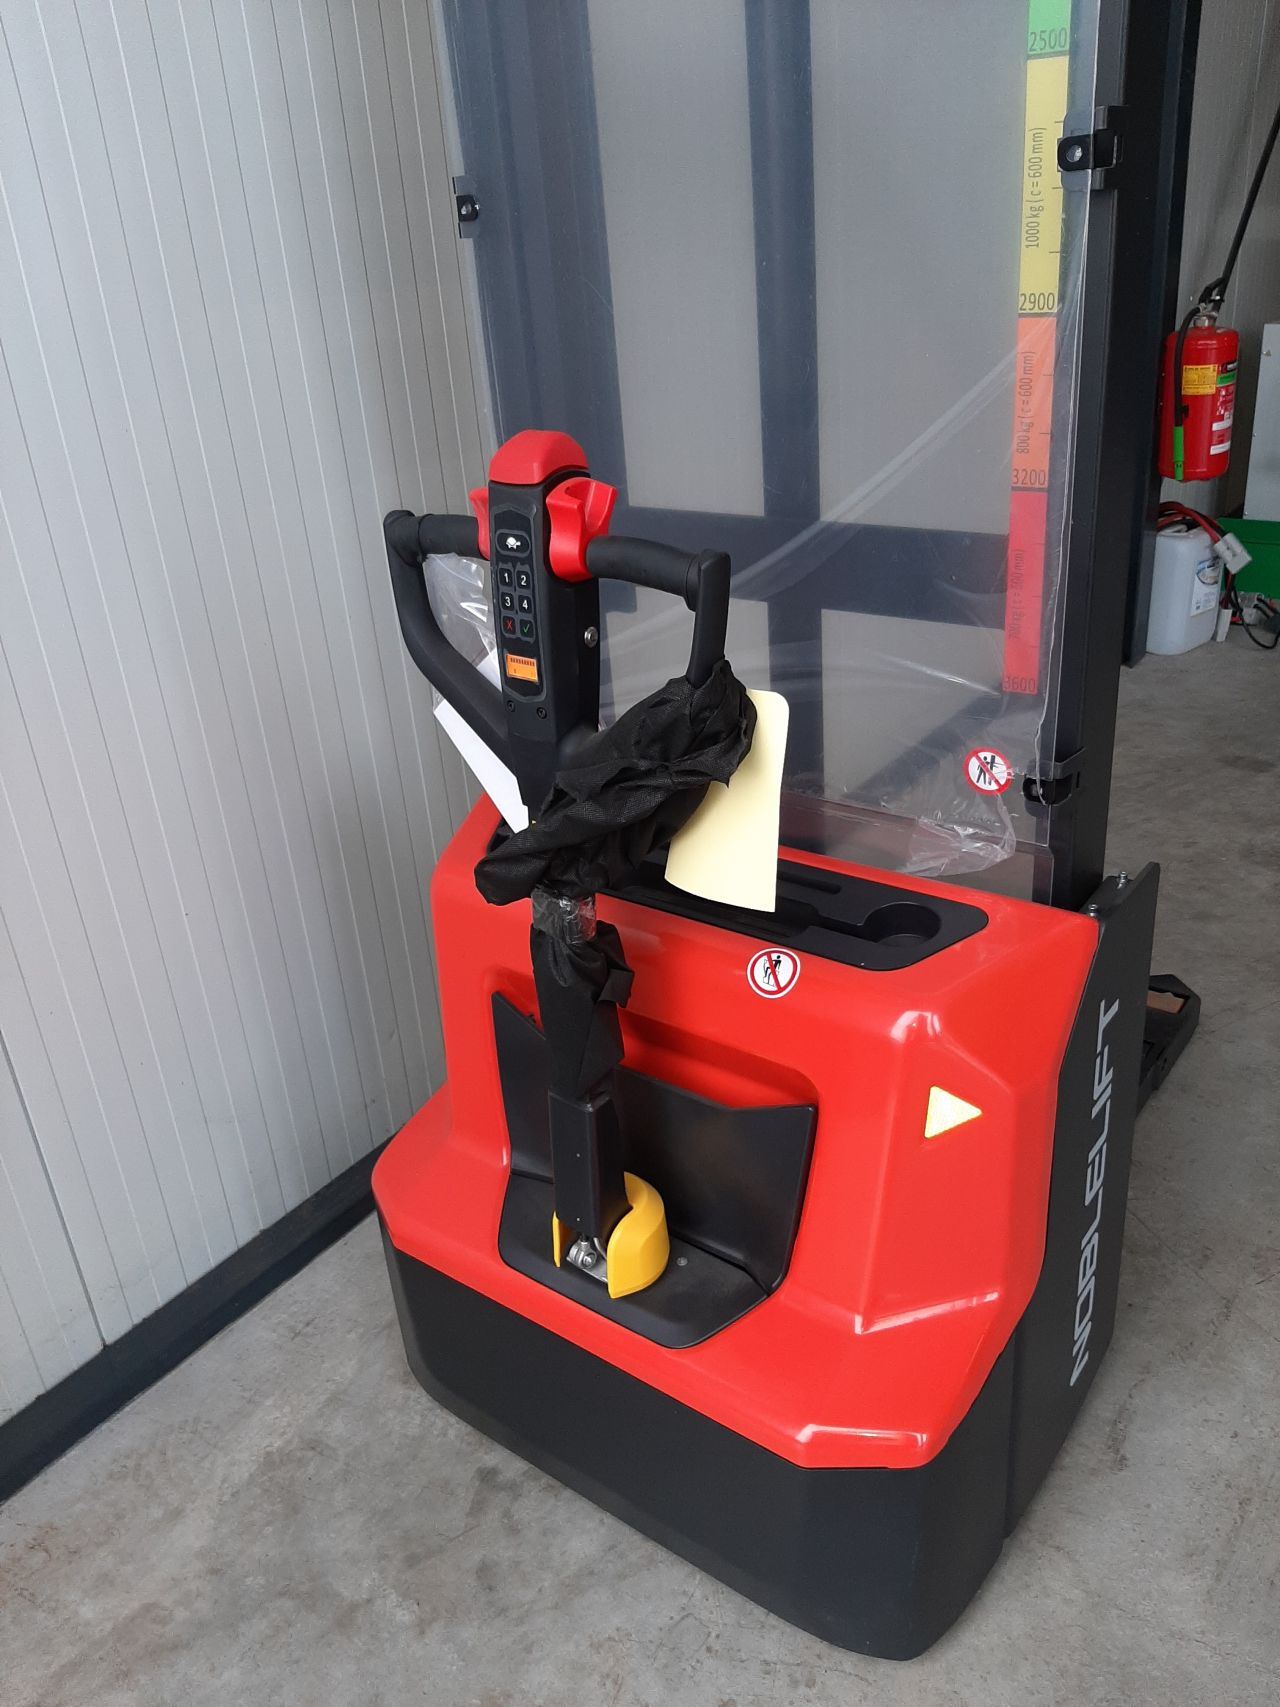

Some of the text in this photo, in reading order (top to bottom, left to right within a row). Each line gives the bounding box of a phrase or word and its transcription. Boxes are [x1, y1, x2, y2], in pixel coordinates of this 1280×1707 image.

[1029, 27, 1067, 52] 2500
[1028, 157, 1042, 178] 600
[1026, 206, 1044, 218] kg
[1025, 221, 1040, 249] 1000
[1019, 292, 1055, 312] 2900
[1017, 377, 1033, 397] 600
[1018, 421, 1034, 433] kg
[1016, 435, 1030, 454] 800
[1012, 468, 1046, 486] 3200
[503, 572, 528, 586] 1 2
[505, 596, 529, 610] 3 4
[1070, 998, 1119, 1387] NOBLELIFT
